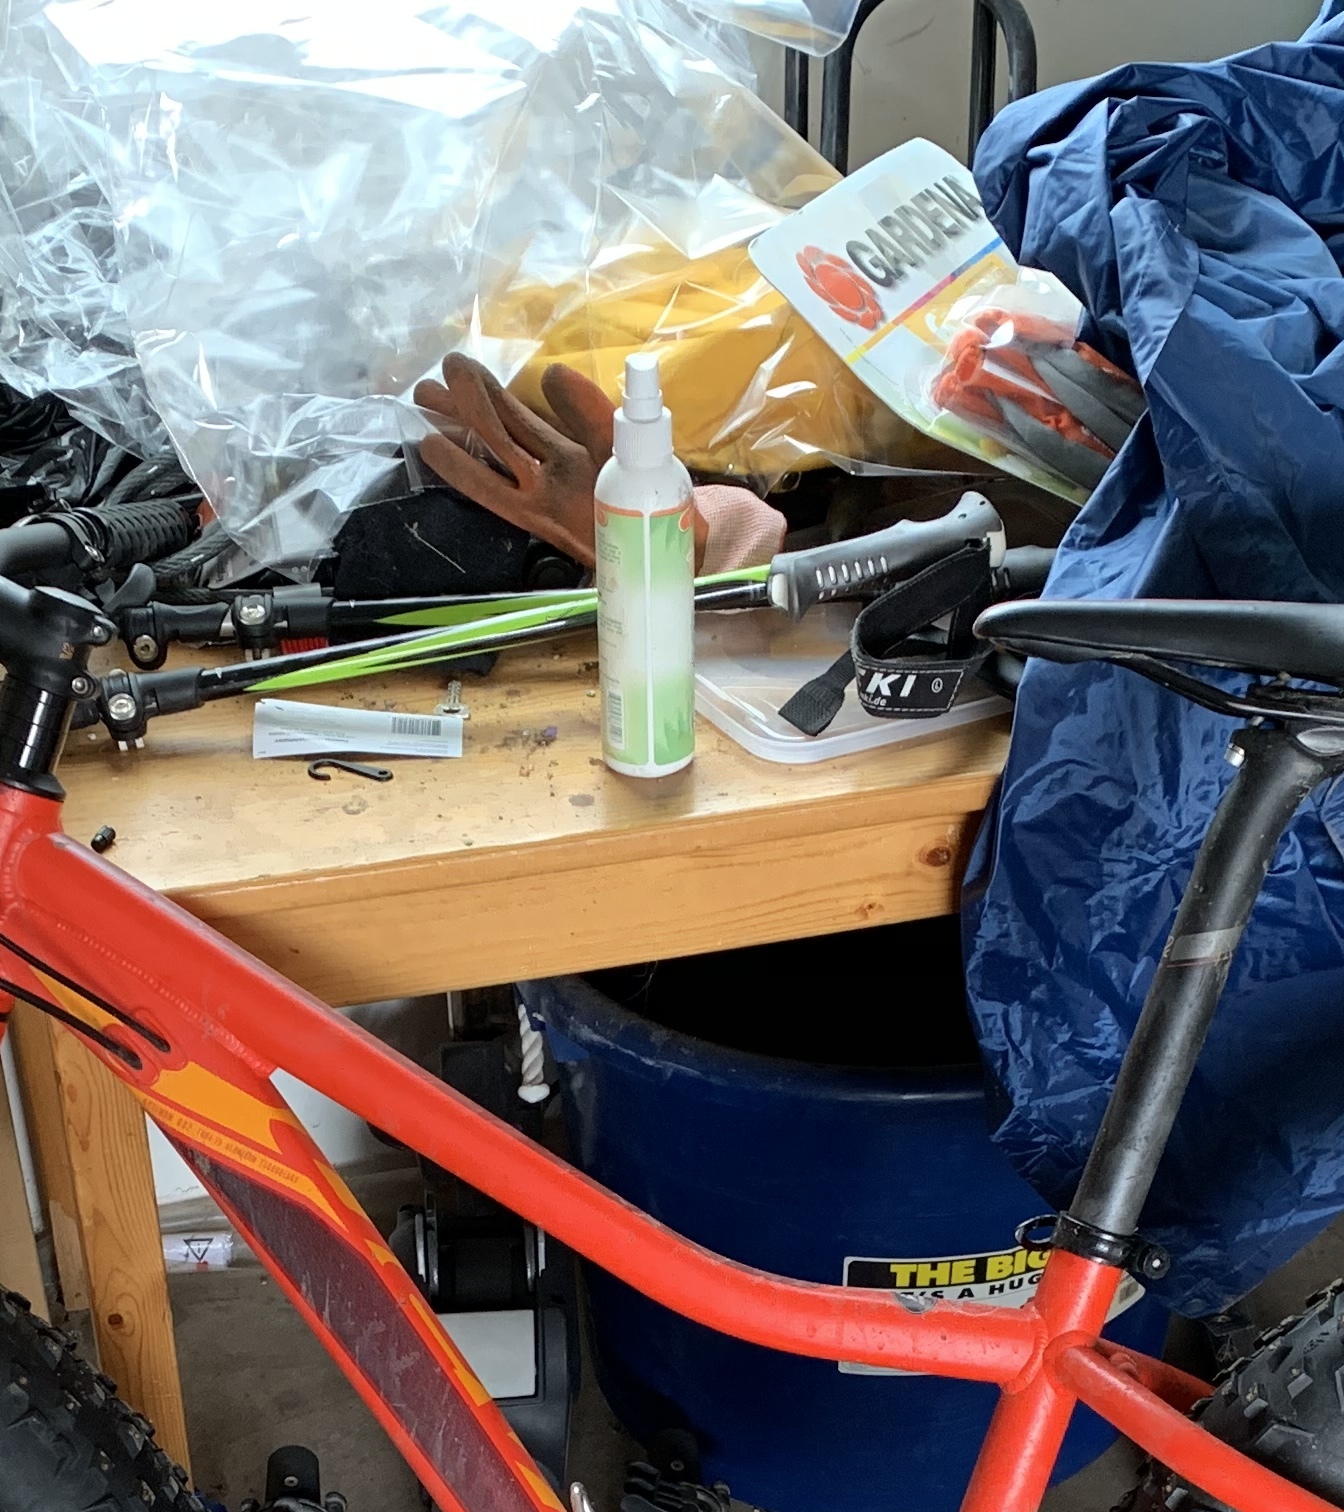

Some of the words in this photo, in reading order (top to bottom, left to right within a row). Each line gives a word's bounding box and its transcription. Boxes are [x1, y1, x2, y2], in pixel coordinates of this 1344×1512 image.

[846, 174, 987, 287] GARDENA
[859, 669, 917, 697] KI
[890, 1259, 975, 1288] THE
[985, 1248, 1051, 1282] BIG
[958, 1287, 974, 1300] A
[988, 1273, 1045, 1296] HUG
